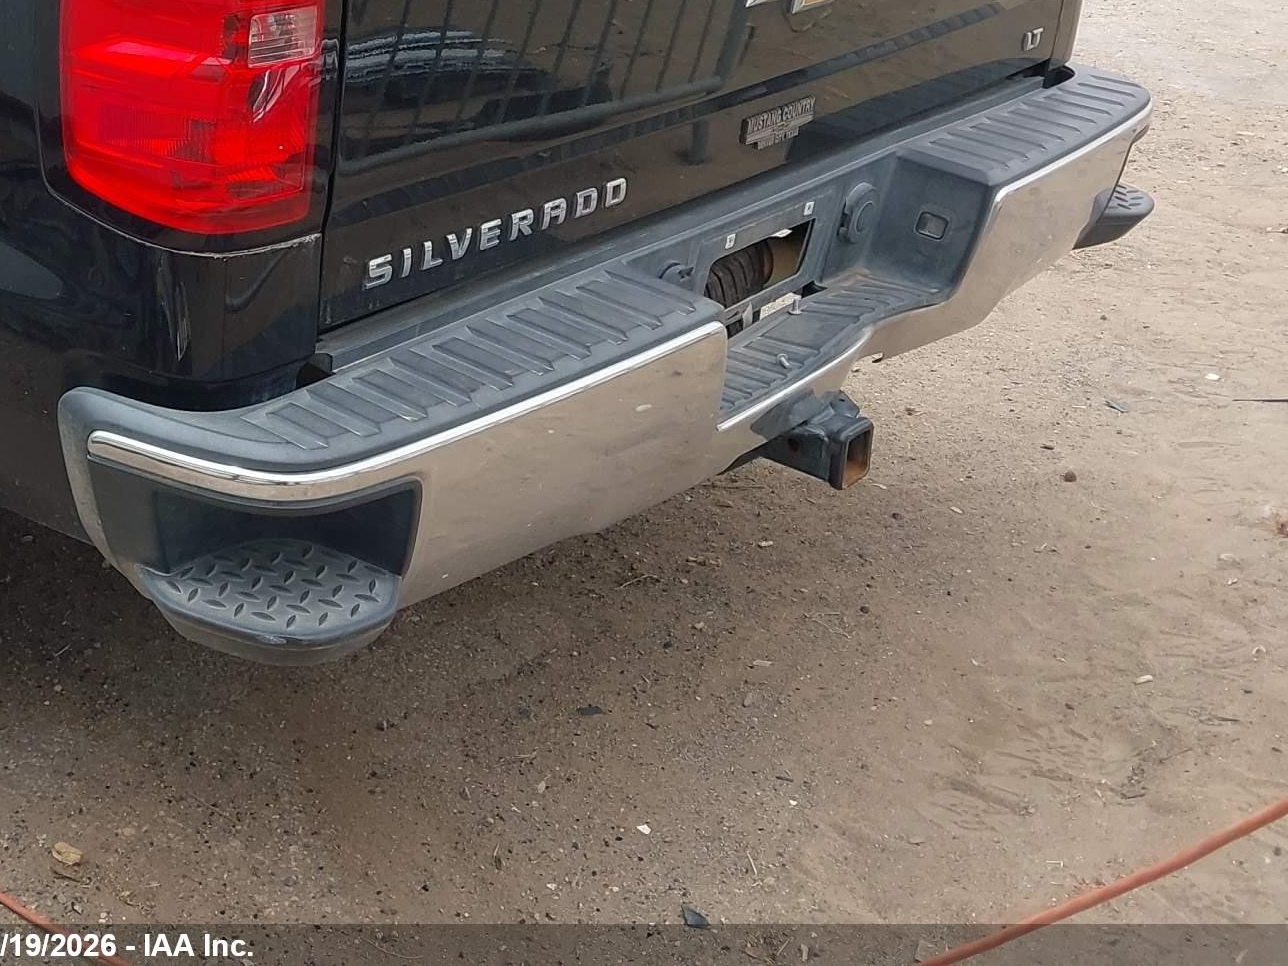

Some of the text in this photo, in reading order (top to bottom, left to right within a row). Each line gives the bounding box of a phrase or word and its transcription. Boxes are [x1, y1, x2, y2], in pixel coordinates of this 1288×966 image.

[1024, 27, 1044, 51] LT
[747, 96, 816, 135] MUSTANG COUNTRY
[364, 177, 628, 290] SILVERADO
